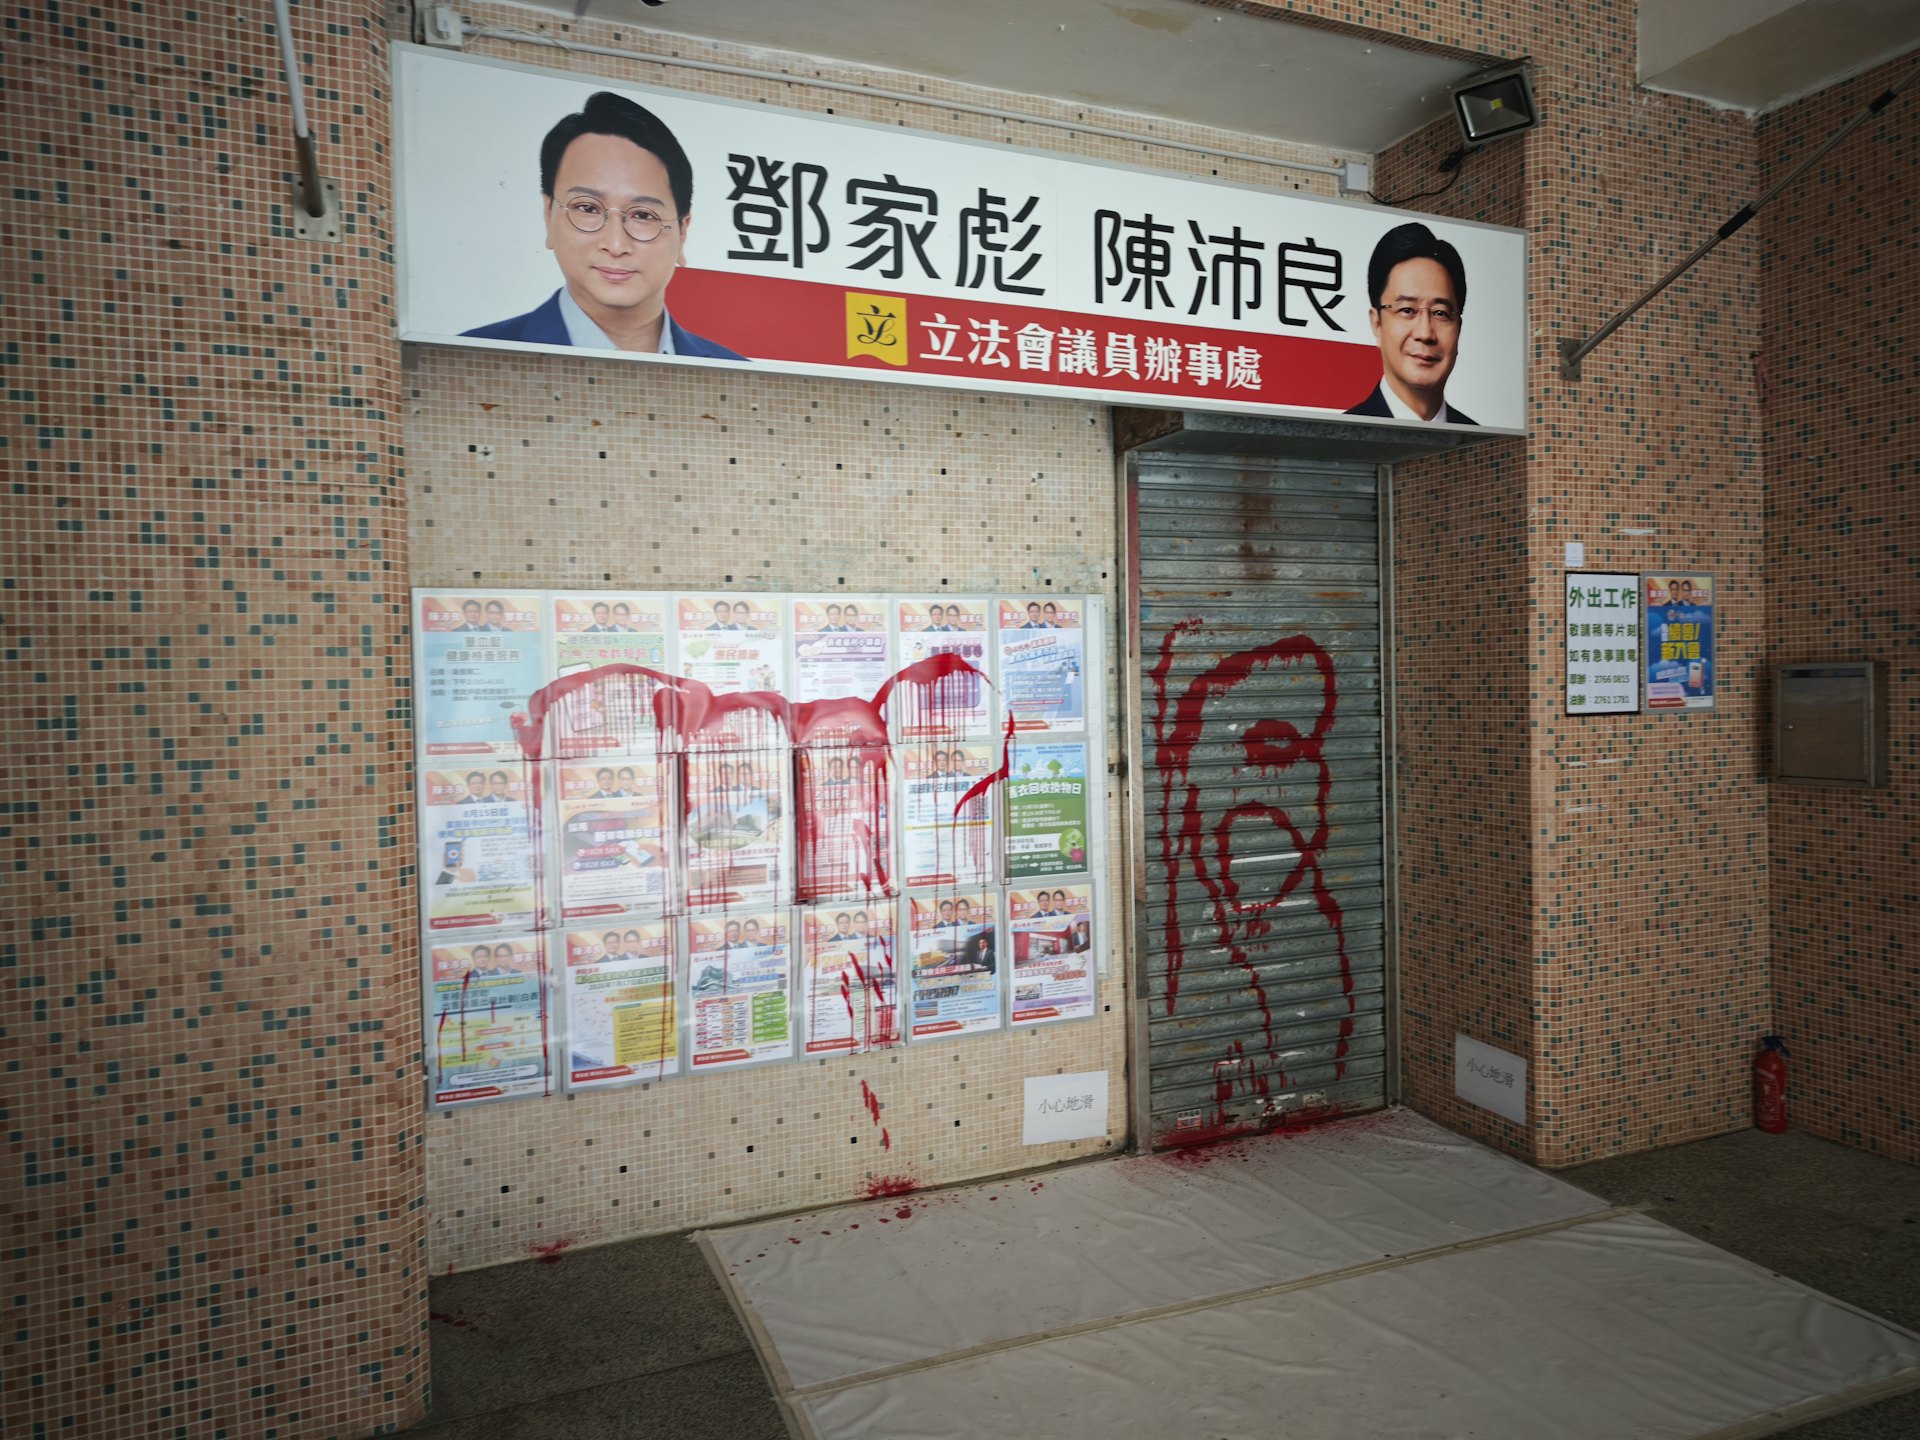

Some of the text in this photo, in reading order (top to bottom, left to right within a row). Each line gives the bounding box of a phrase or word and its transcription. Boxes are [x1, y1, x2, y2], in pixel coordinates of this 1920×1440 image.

[726, 153, 1347, 332] 鄧家彪 陳沛良
[919, 312, 1262, 392] 立法會議員辦事處
[1569, 586, 1637, 609] 外出工作
[1569, 623, 1637, 638] 敬請稍等片刻
[1569, 648, 1638, 663] 如有急事請電
[1466, 1058, 1514, 1088] 小心地滑
[1038, 1094, 1094, 1114] 小心地滑
